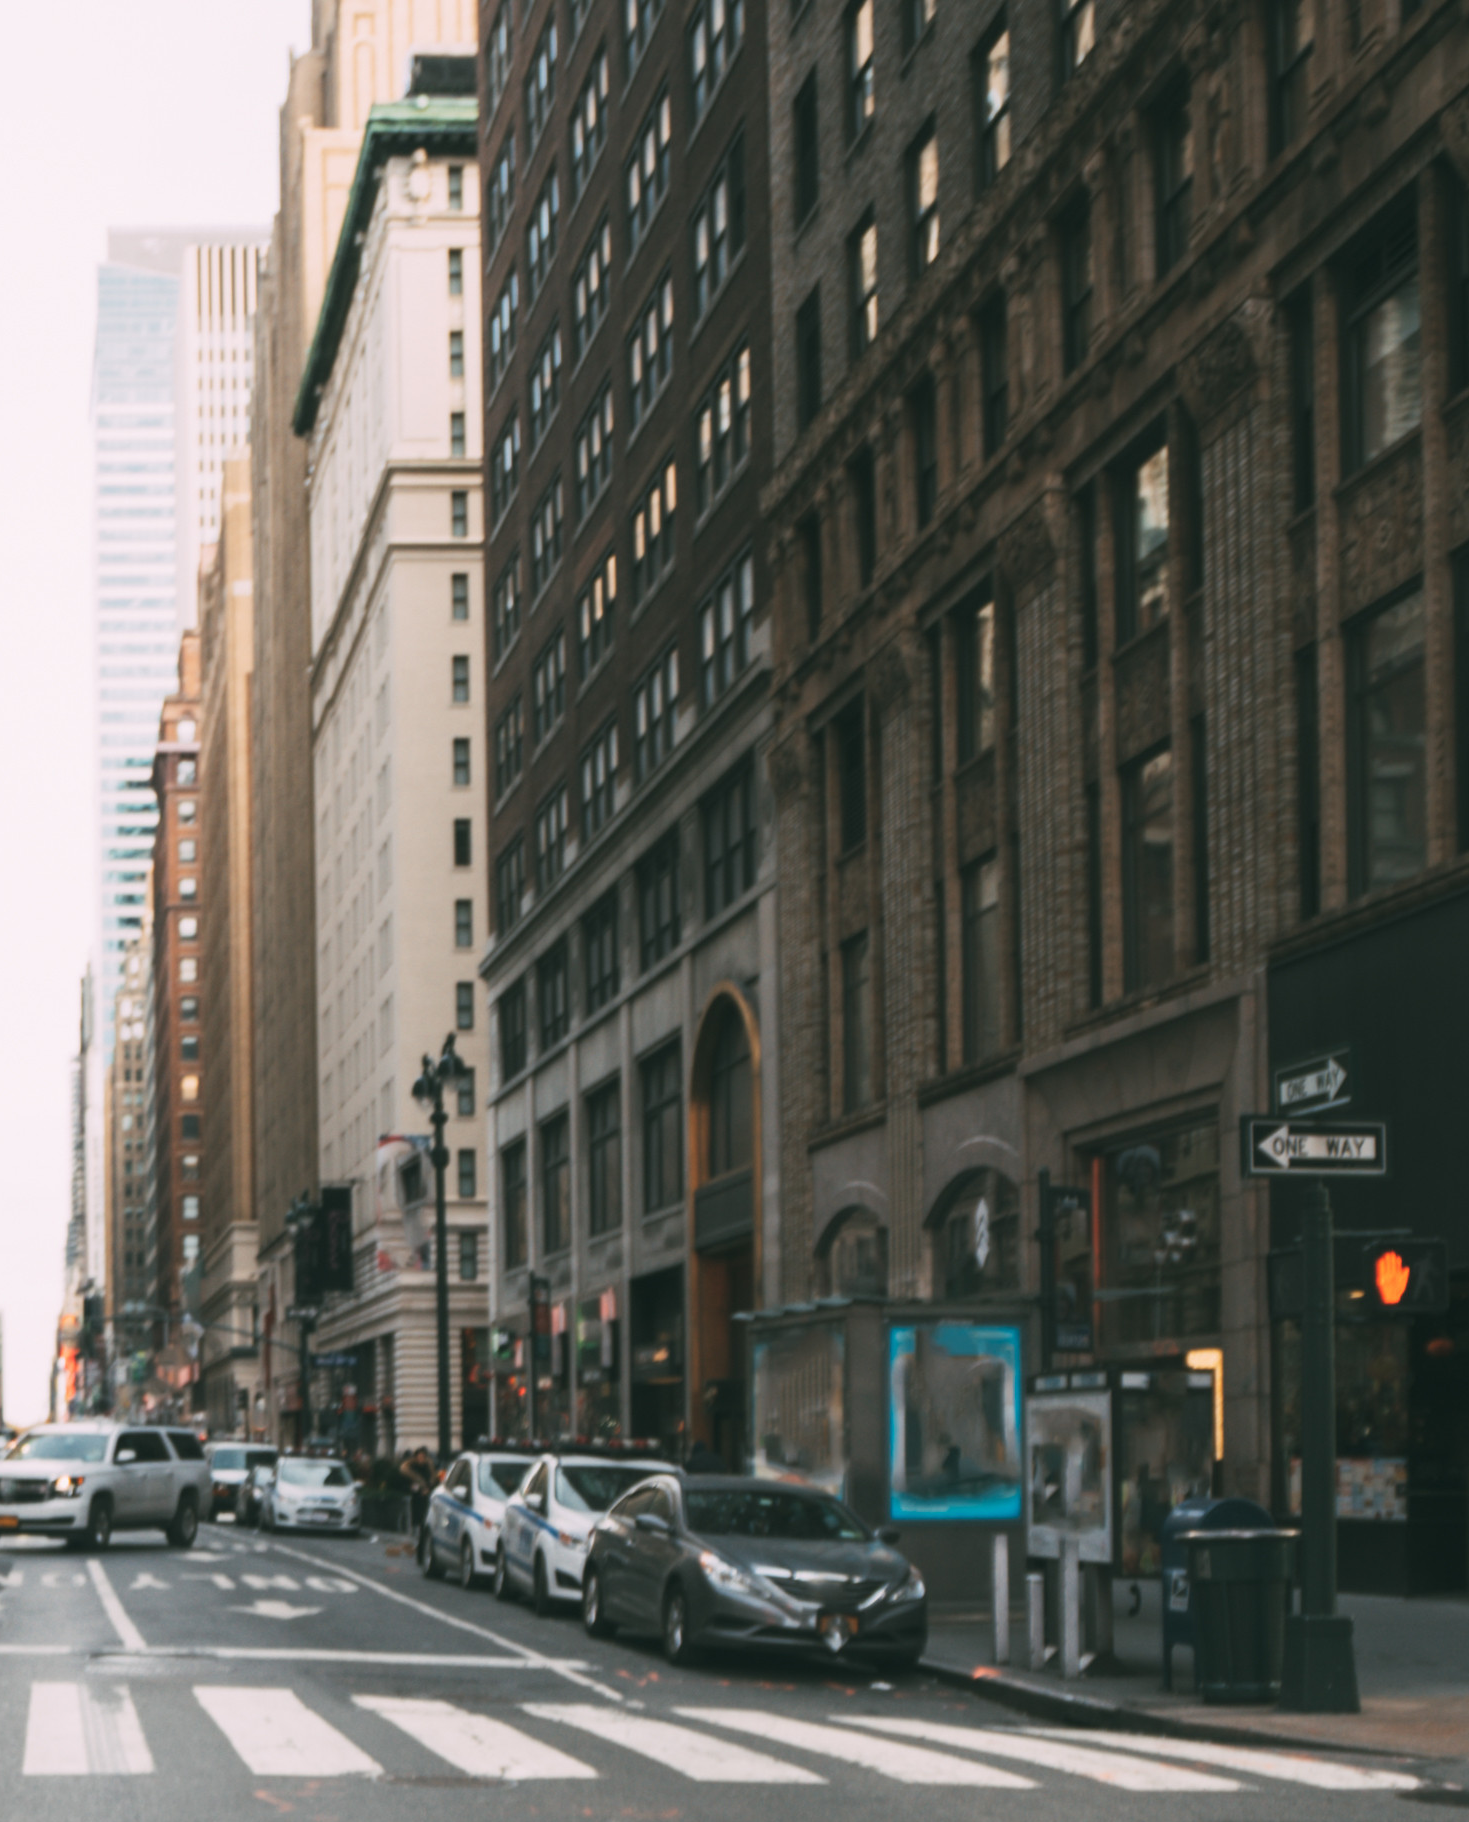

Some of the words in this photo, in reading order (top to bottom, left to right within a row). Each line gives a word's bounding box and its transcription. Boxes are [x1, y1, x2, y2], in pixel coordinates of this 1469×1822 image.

[1287, 1079, 1308, 1099] ONE
[1316, 1069, 1340, 1090] WAY
[1272, 1137, 1309, 1157] ONE
[1326, 1137, 1366, 1157] WAY
